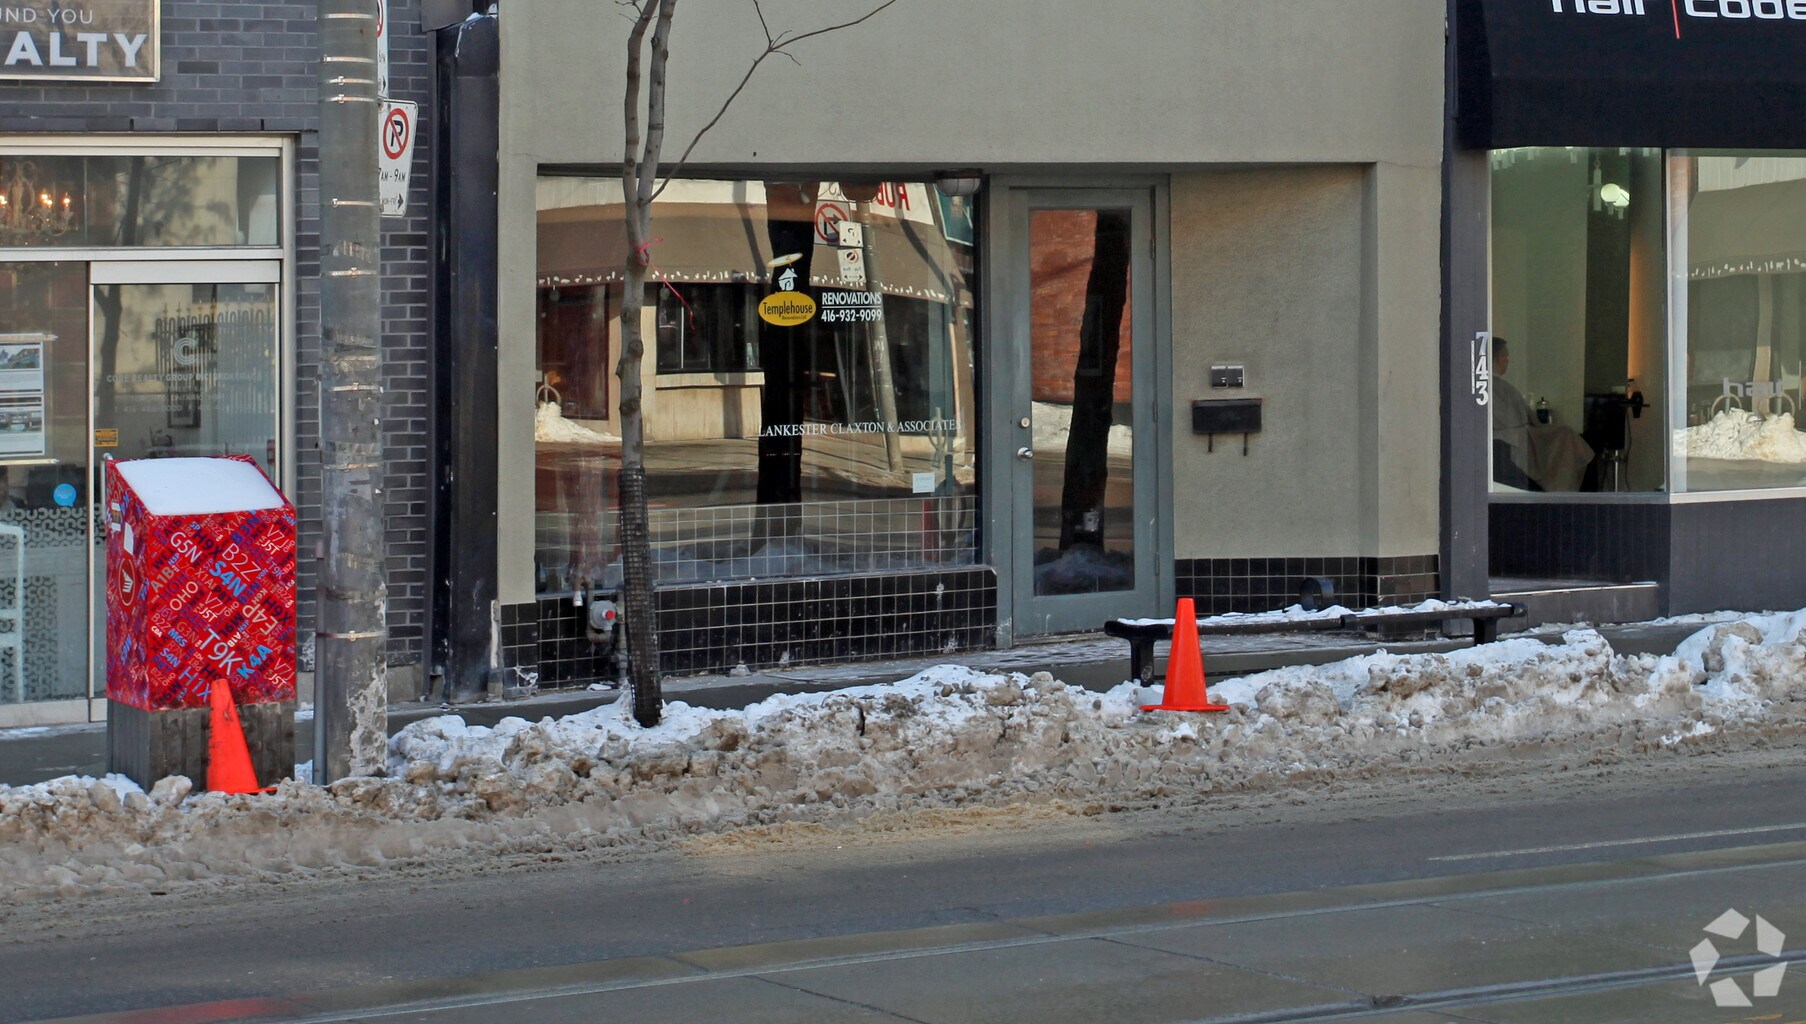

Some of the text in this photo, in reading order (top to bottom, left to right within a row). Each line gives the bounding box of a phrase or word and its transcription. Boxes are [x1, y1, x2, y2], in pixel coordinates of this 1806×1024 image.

[0, 7, 93, 24] ND YOU
[4, 31, 148, 68] ALTY
[763, 300, 813, 317] Templehouse
[821, 292, 882, 306] RENOVATIONS
[821, 309, 882, 322] 416-932-9099
[107, 374, 129, 382] CORE
[166, 373, 193, 382] GROUP
[1475, 331, 1489, 406] 743
[758, 419, 962, 438] LANKESTER CLAXTON & ASSOCIATES
[170, 531, 203, 564] G5N
[261, 539, 280, 555] J5T
[221, 542, 262, 583] B2Z
[208, 561, 248, 597] S4N
[199, 607, 218, 623] J5T
[199, 628, 244, 678] T9K
[236, 644, 274, 680] K4A
[178, 666, 213, 704] H1X
